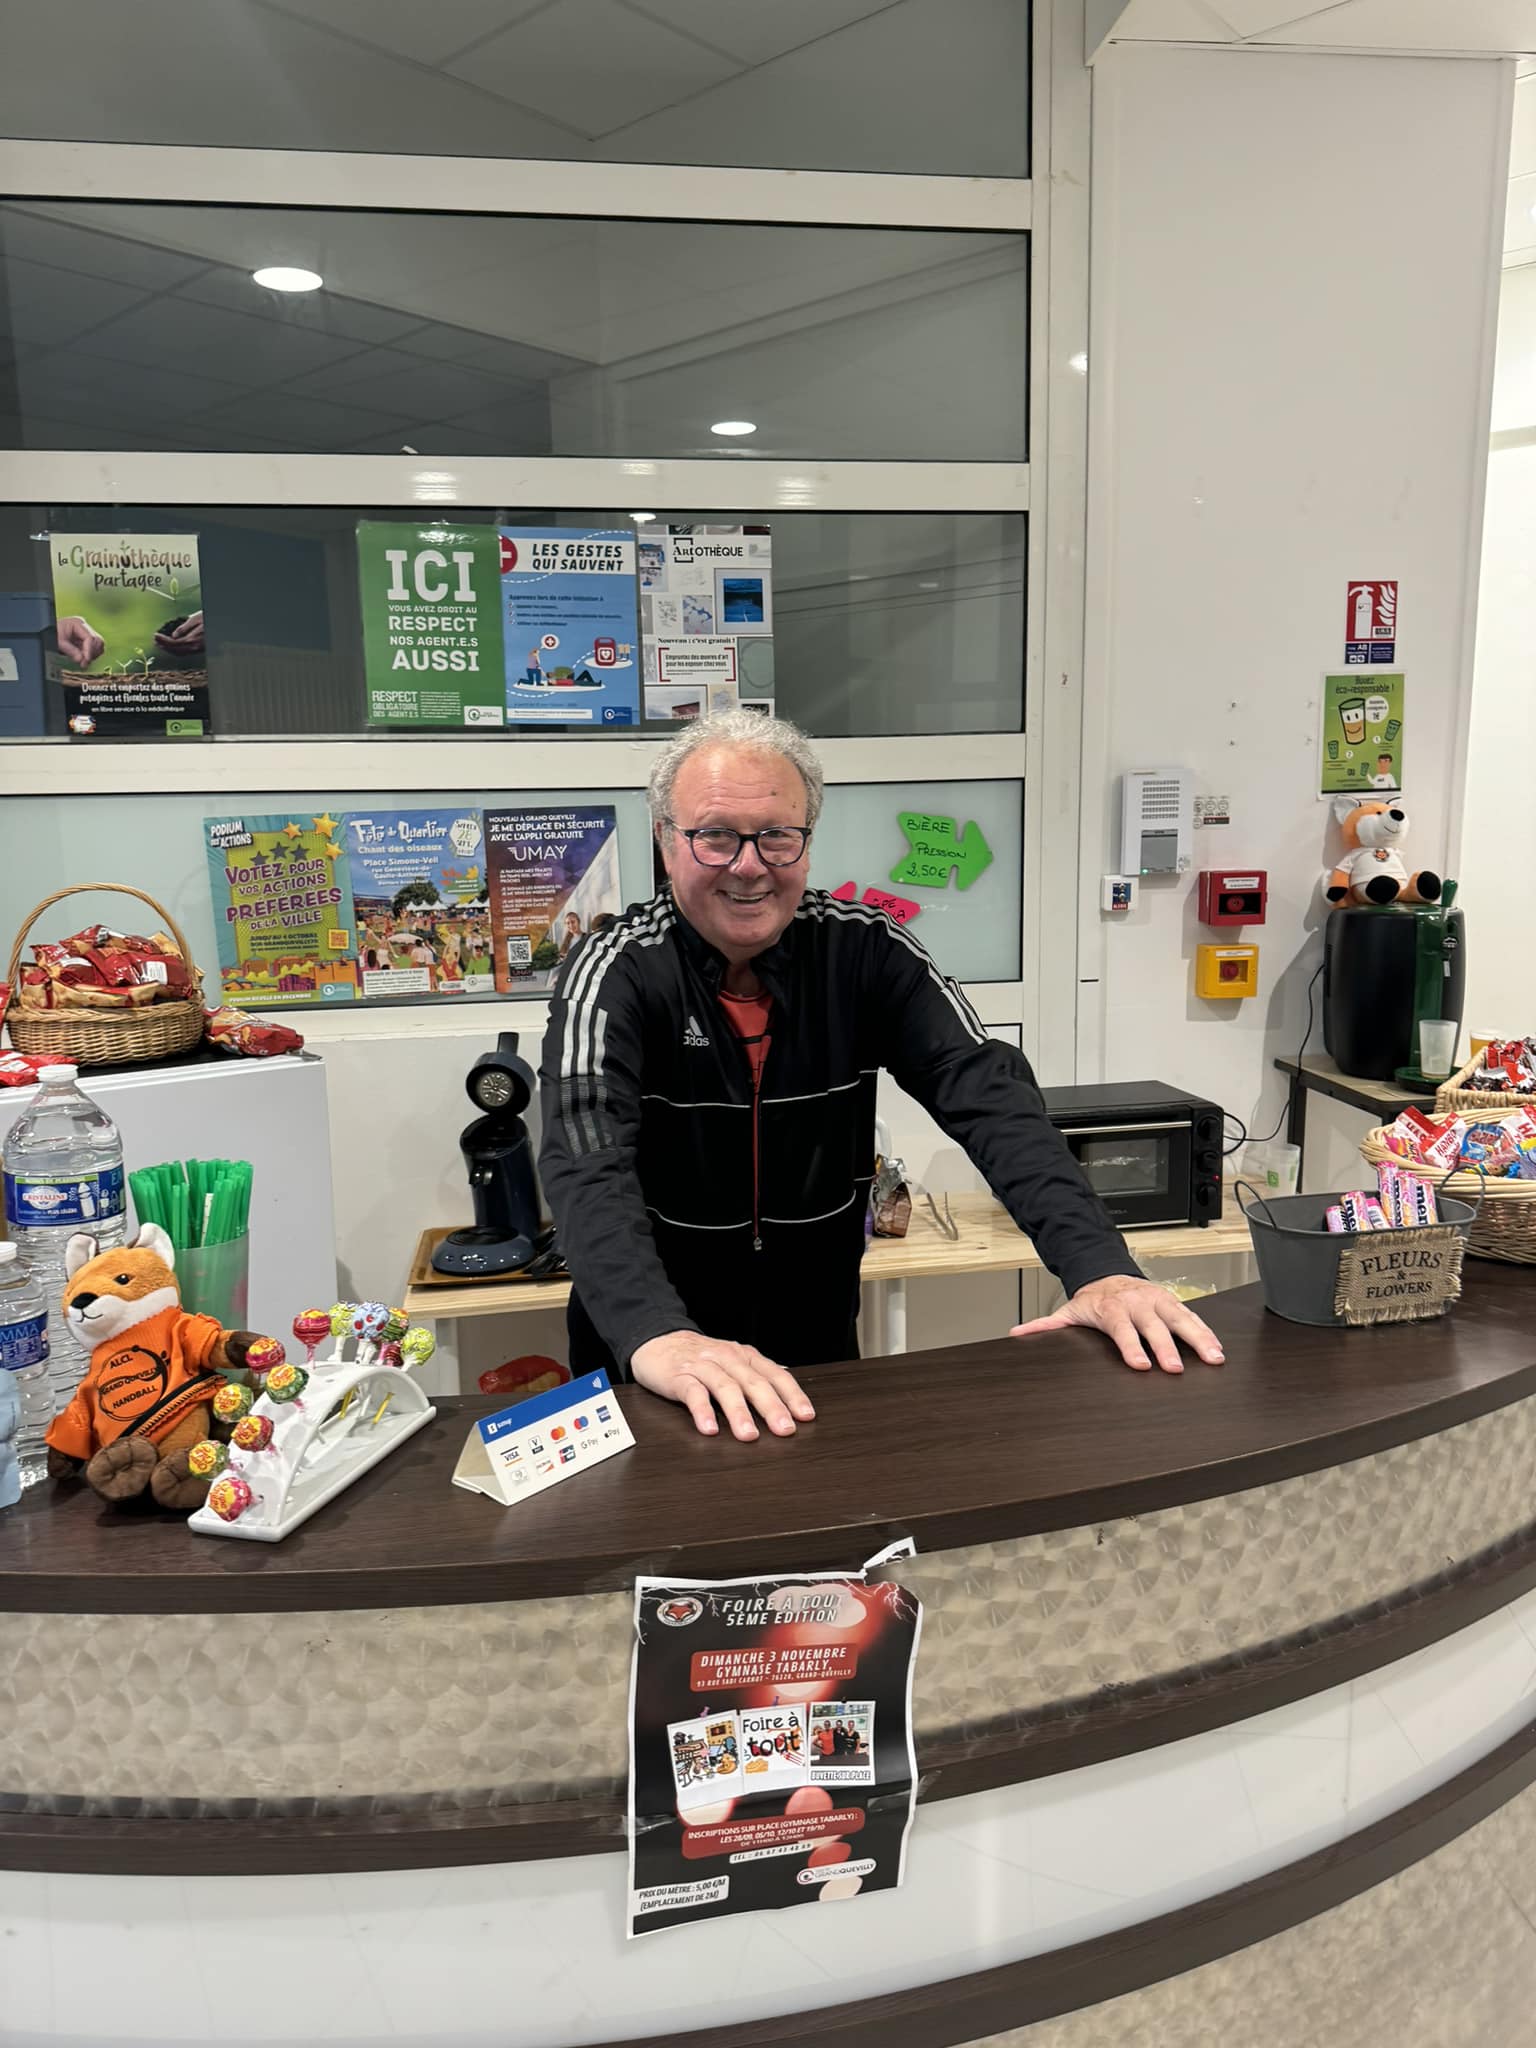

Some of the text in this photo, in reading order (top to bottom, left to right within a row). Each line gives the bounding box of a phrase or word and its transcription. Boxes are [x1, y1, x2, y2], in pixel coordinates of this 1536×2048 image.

[58, 552, 68, 566] la
[532, 543, 623, 558] LES GESTES
[532, 558, 624, 572] QUI SAUVENT
[94, 568, 162, 592] partagée
[385, 549, 477, 602] ICI
[388, 604, 477, 614] VOUS AVEZ DROIT AU
[388, 615, 478, 632] RESPECT
[389, 635, 478, 647] NOS AGENT.E.S
[391, 649, 480, 671] AUSSI
[82, 683, 109, 693] Donnez
[110, 683, 117, 692] et
[151, 682, 164, 692] des
[372, 690, 418, 702] RESPECT
[115, 694, 122, 702] et
[150, 694, 169, 702] toute
[210, 820, 243, 837] PODIUM
[398, 820, 448, 843] Quartier
[490, 824, 500, 832] JE
[501, 824, 514, 832] ME
[515, 822, 553, 831] DÉPLACE
[567, 819, 605, 829] SÉCURITÉ
[220, 833, 252, 848] ACTIONS
[490, 831, 584, 842] AVEC L'APPLI GRATUITE
[358, 844, 442, 853] Chant des oiseaux
[507, 844, 568, 861] UMAY
[915, 841, 967, 859] PRESSION
[225, 859, 325, 885] VOTEZ POUR
[239, 873, 326, 895] VOS ACTIONS
[226, 885, 342, 922] PRÉFÉRÉES
[281, 910, 321, 926] VILLE
[1360, 1250, 1443, 1276] FLEURS
[1397, 1269, 1407, 1280] &
[1366, 1281, 1433, 1299] FLOWERS
[110, 1354, 133, 1369] ALCL
[112, 1385, 158, 1409] HANDBALL
[588, 1438, 599, 1447] Pay
[608, 1428, 620, 1437] Pay
[504, 1450, 520, 1461] VISA
[722, 1593, 842, 1613] FOIRE À TOUT
[726, 1609, 838, 1627] 5ÈME EDITION
[700, 1647, 847, 1667] DIMANCHE 3 NOVEMBRE
[716, 1659, 832, 1679] GYMNASE TABARLY,
[707, 1679, 720, 1687] RUE
[743, 1712, 800, 1733] Foire à
[747, 1731, 801, 1757] tout
[688, 1813, 855, 1839] INSCRIPTIONS SUR PLACE (GYMNASE TABARLY)
[720, 1835, 733, 1844] LES
[639, 1890, 656, 1899] PRIX
[657, 1888, 667, 1896] DU
[640, 1890, 719, 1912] (EMPLACEMENT DE 2M)
